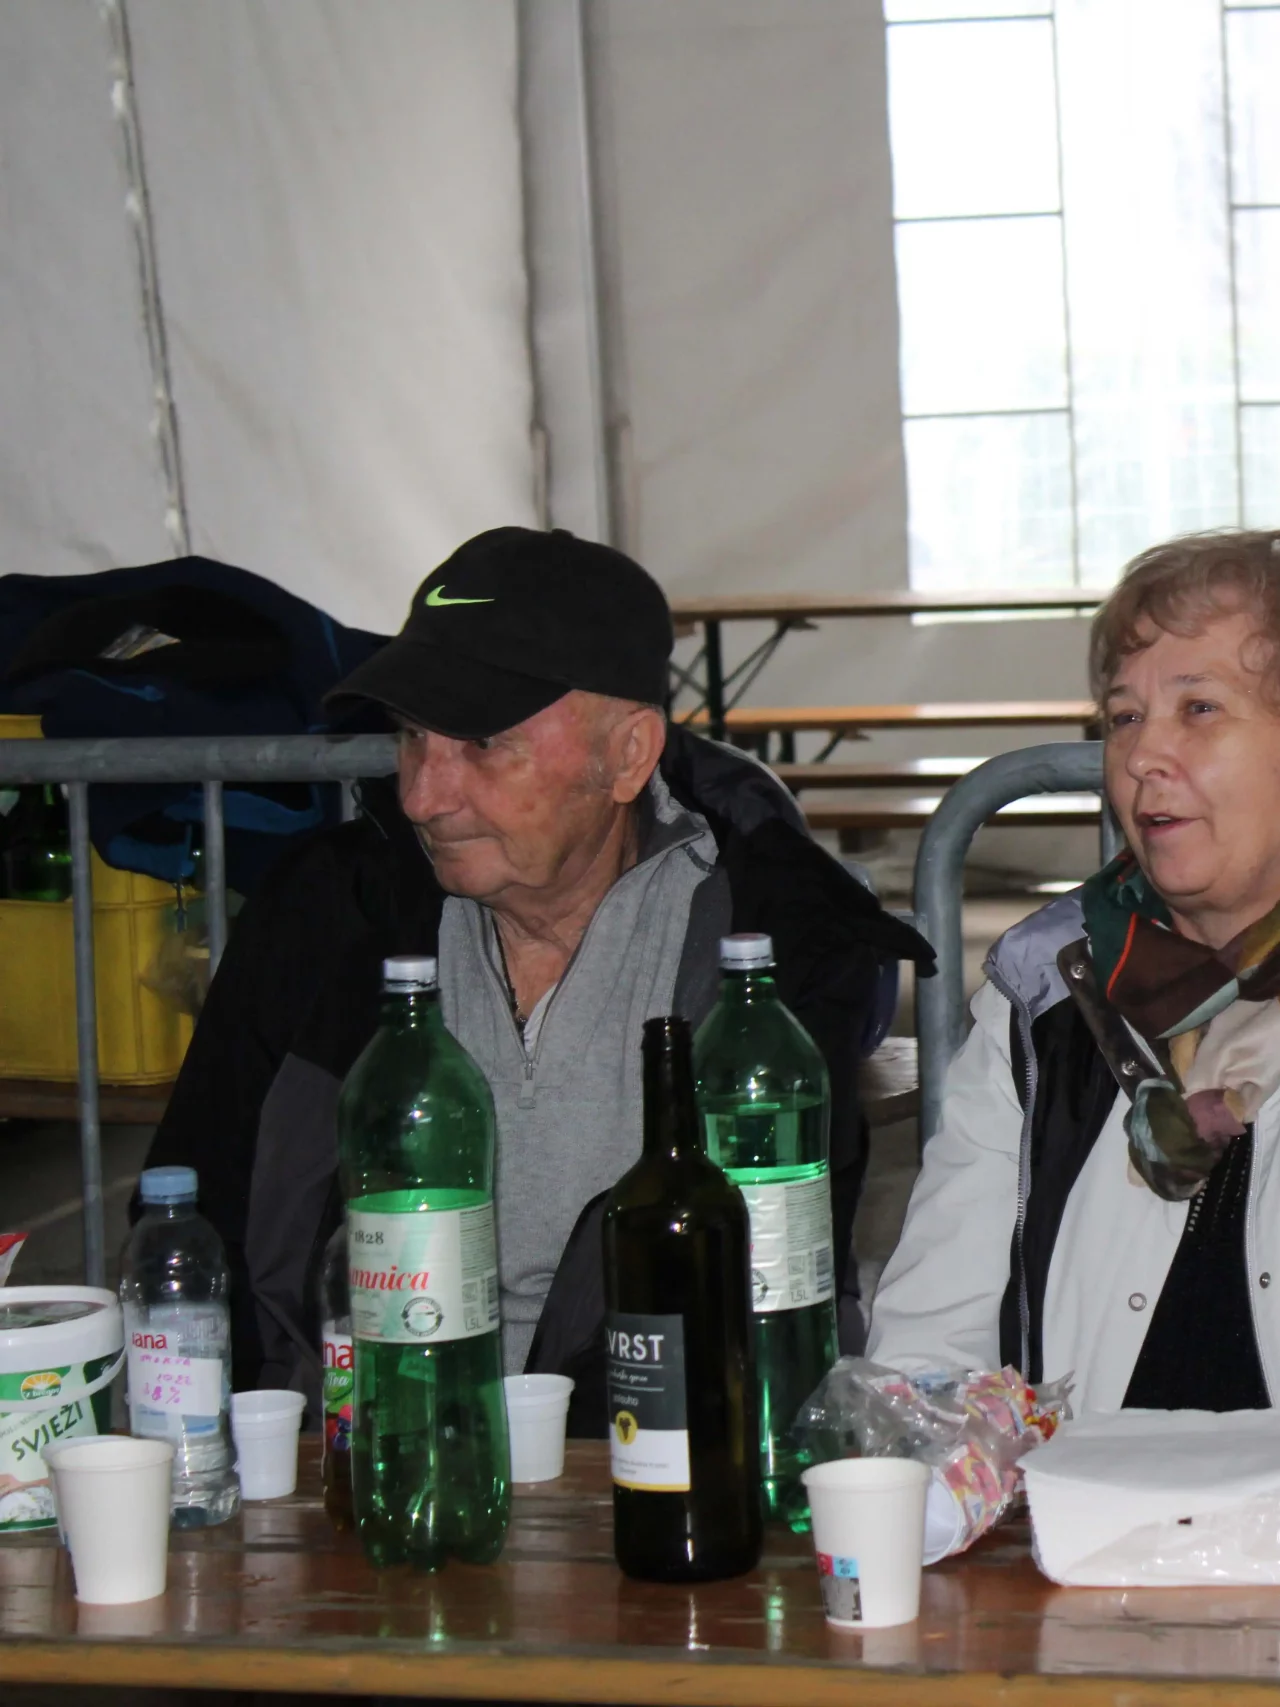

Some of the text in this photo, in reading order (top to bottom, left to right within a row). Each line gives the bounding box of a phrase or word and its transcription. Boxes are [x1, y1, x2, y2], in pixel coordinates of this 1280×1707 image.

[355, 1230, 384, 1245] 1828
[322, 1341, 354, 1369] na
[606, 1328, 665, 1362] VRST
[11, 1400, 83, 1462] SVJEŽI
